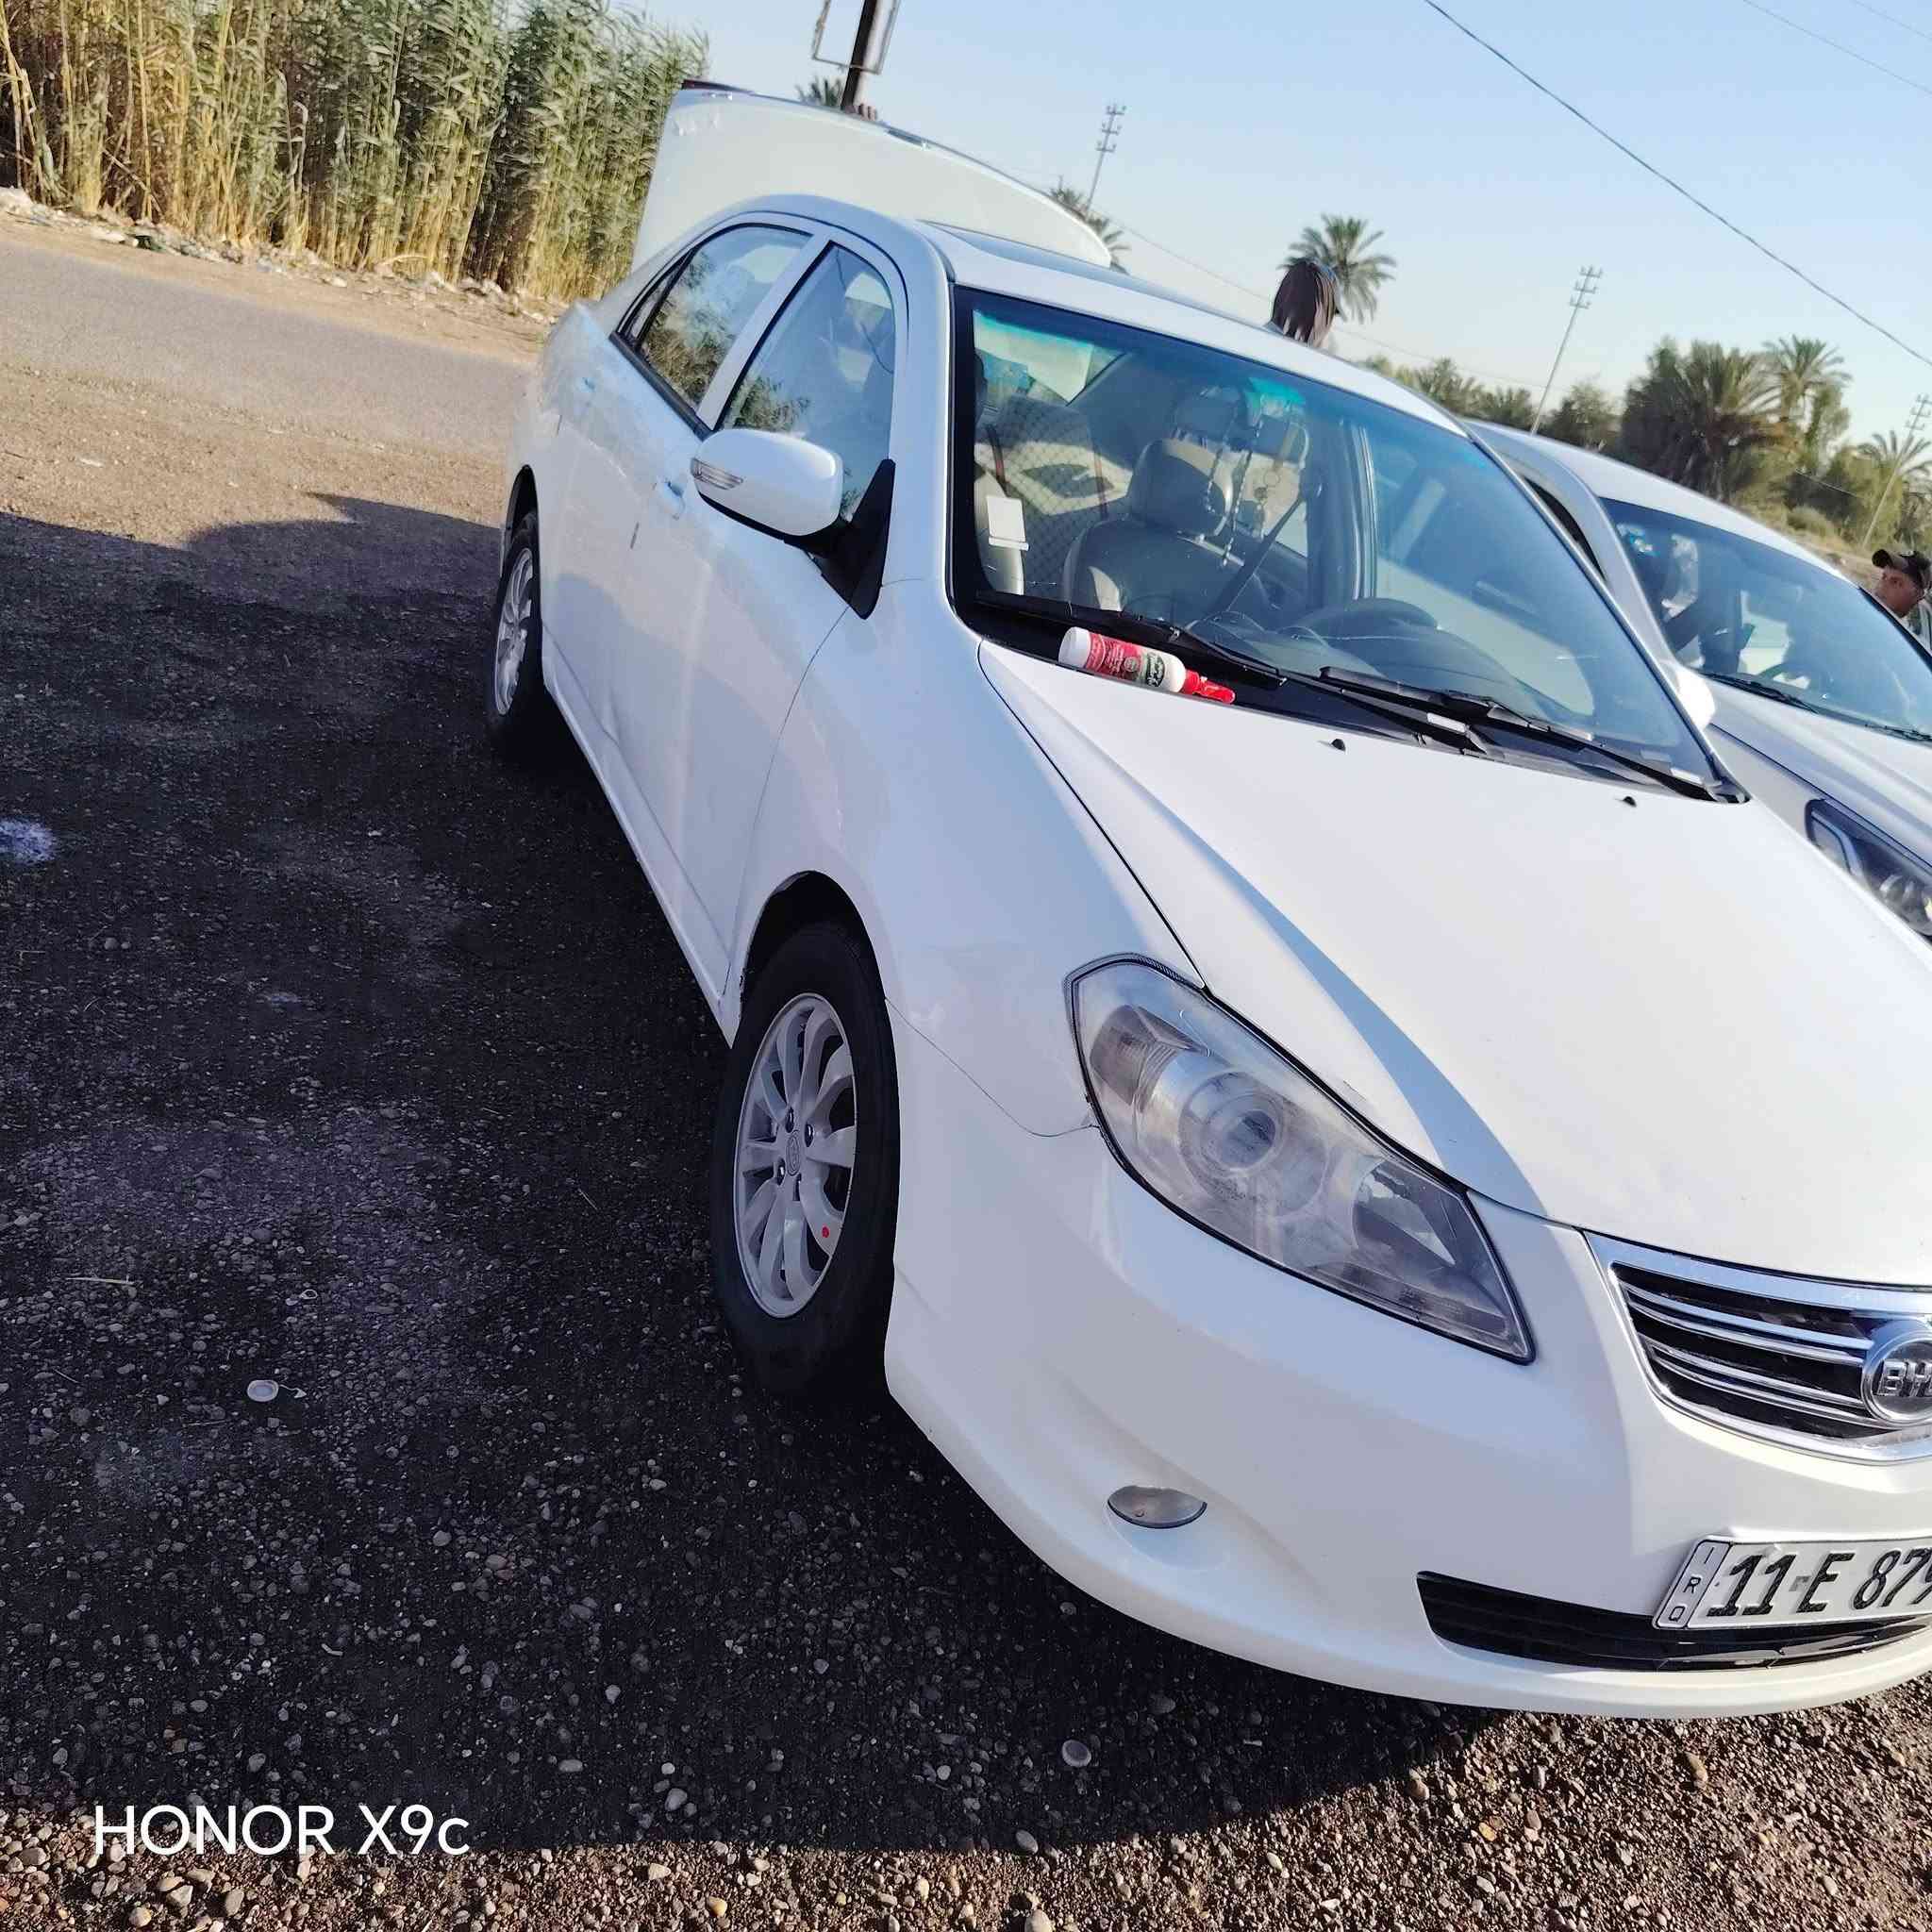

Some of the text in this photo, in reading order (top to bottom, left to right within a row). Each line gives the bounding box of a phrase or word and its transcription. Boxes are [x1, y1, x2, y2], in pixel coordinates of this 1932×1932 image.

[1877, 1358, 1932, 1397] BY
[1706, 1554, 1797, 1617] 11
[1796, 1553, 1855, 1613] E
